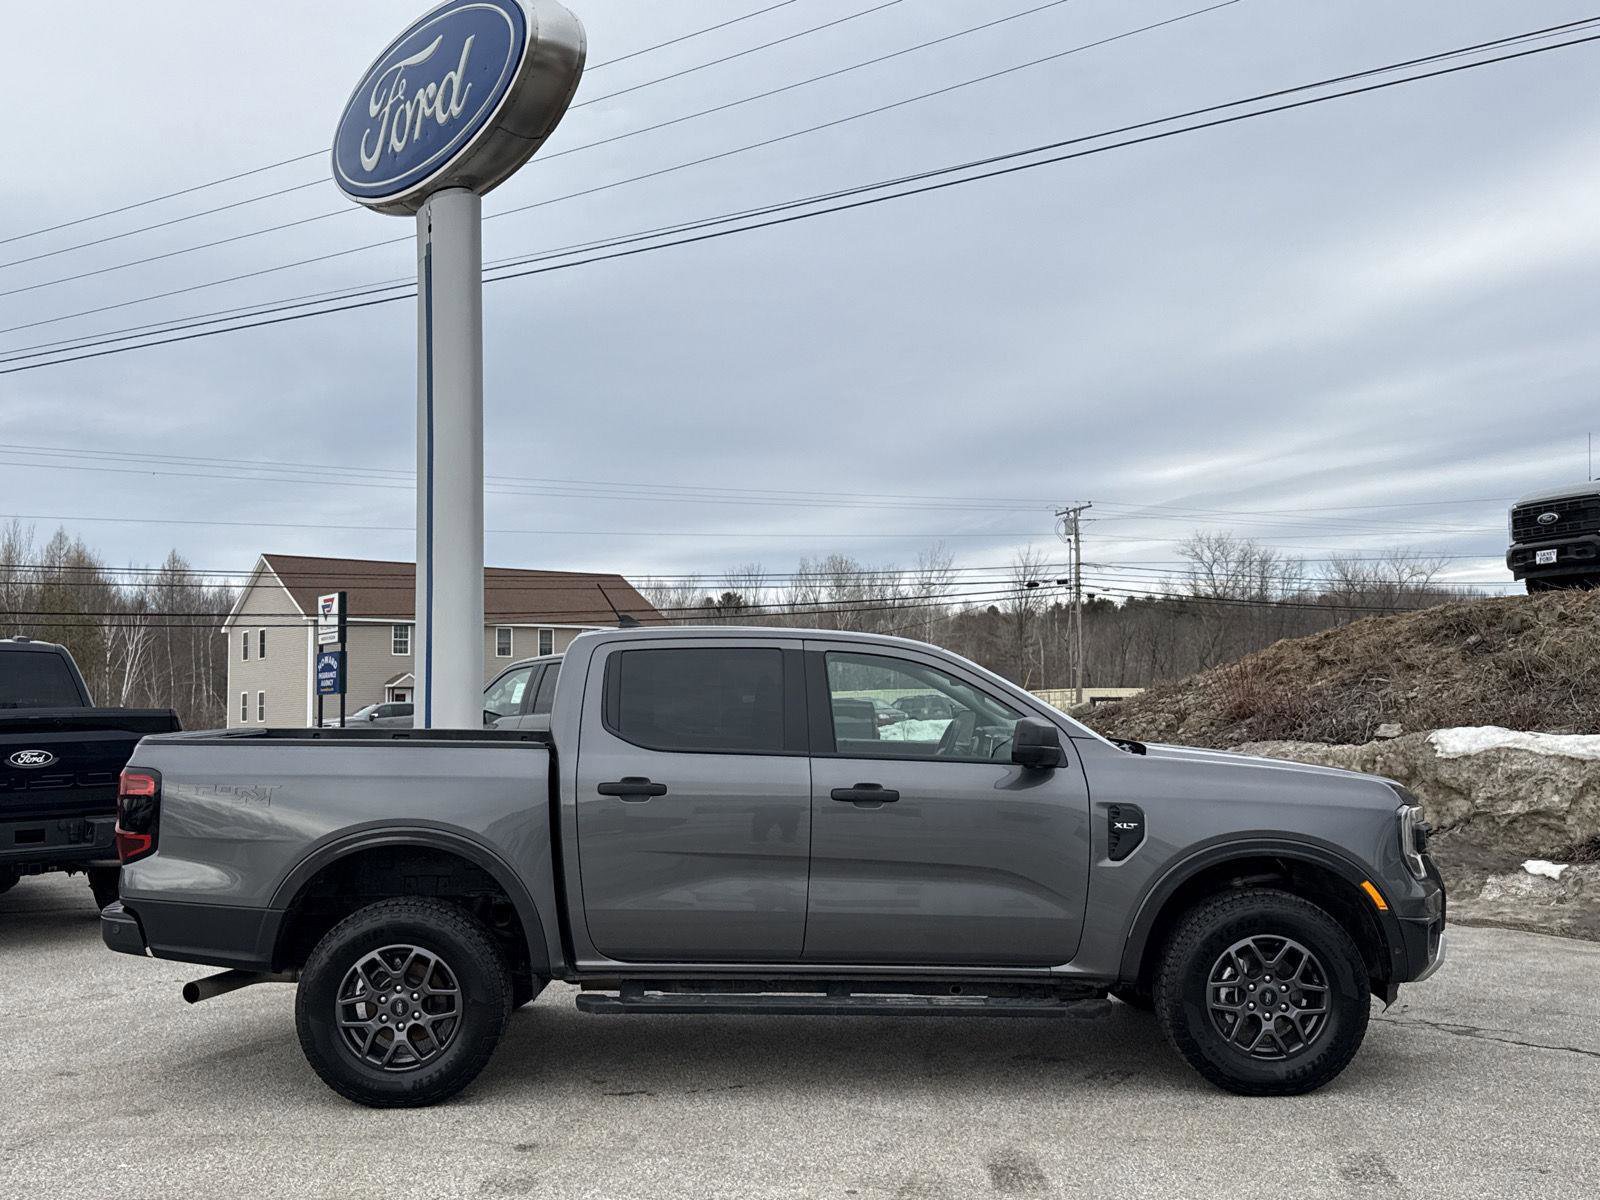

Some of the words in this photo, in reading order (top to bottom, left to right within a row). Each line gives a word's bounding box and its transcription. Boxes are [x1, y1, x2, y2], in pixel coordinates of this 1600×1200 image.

[360, 34, 476, 172] Ford
[17, 752, 46, 764] Ford
[1113, 822, 1139, 830] XLT
